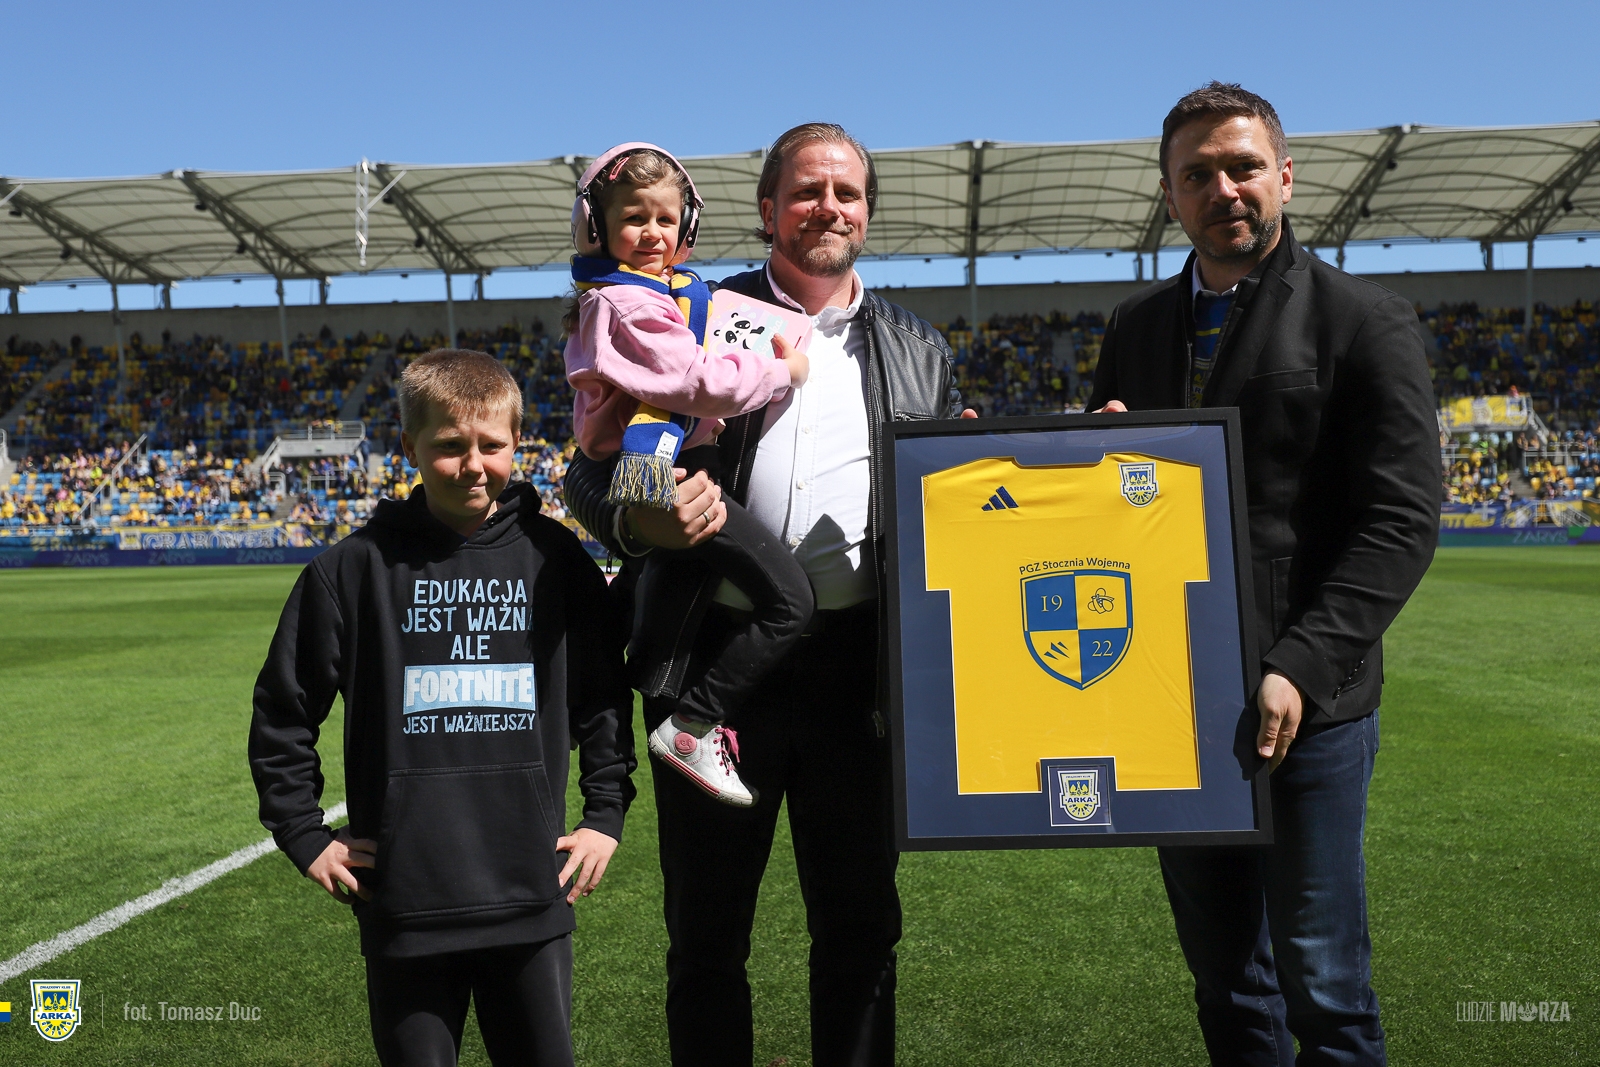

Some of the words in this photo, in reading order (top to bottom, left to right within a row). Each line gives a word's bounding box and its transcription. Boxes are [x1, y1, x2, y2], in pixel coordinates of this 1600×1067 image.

[1512, 529, 1568, 544] ZARYS
[62, 552, 109, 566] ZARYS
[148, 551, 196, 564] ZARYS
[236, 549, 285, 563] ZARYS
[1019, 562, 1041, 575] PGZ
[1042, 558, 1084, 570] Stocznia
[1086, 557, 1131, 570] Wojenna
[413, 578, 527, 605] EDUKACJA
[1041, 594, 1063, 612] 19
[401, 607, 457, 633] JEST
[450, 634, 491, 661] ALE
[1092, 640, 1113, 657] 22
[405, 667, 533, 707] FORTNITE
[402, 714, 439, 735] JEST
[444, 711, 536, 733] WAŻNIEJSZY
